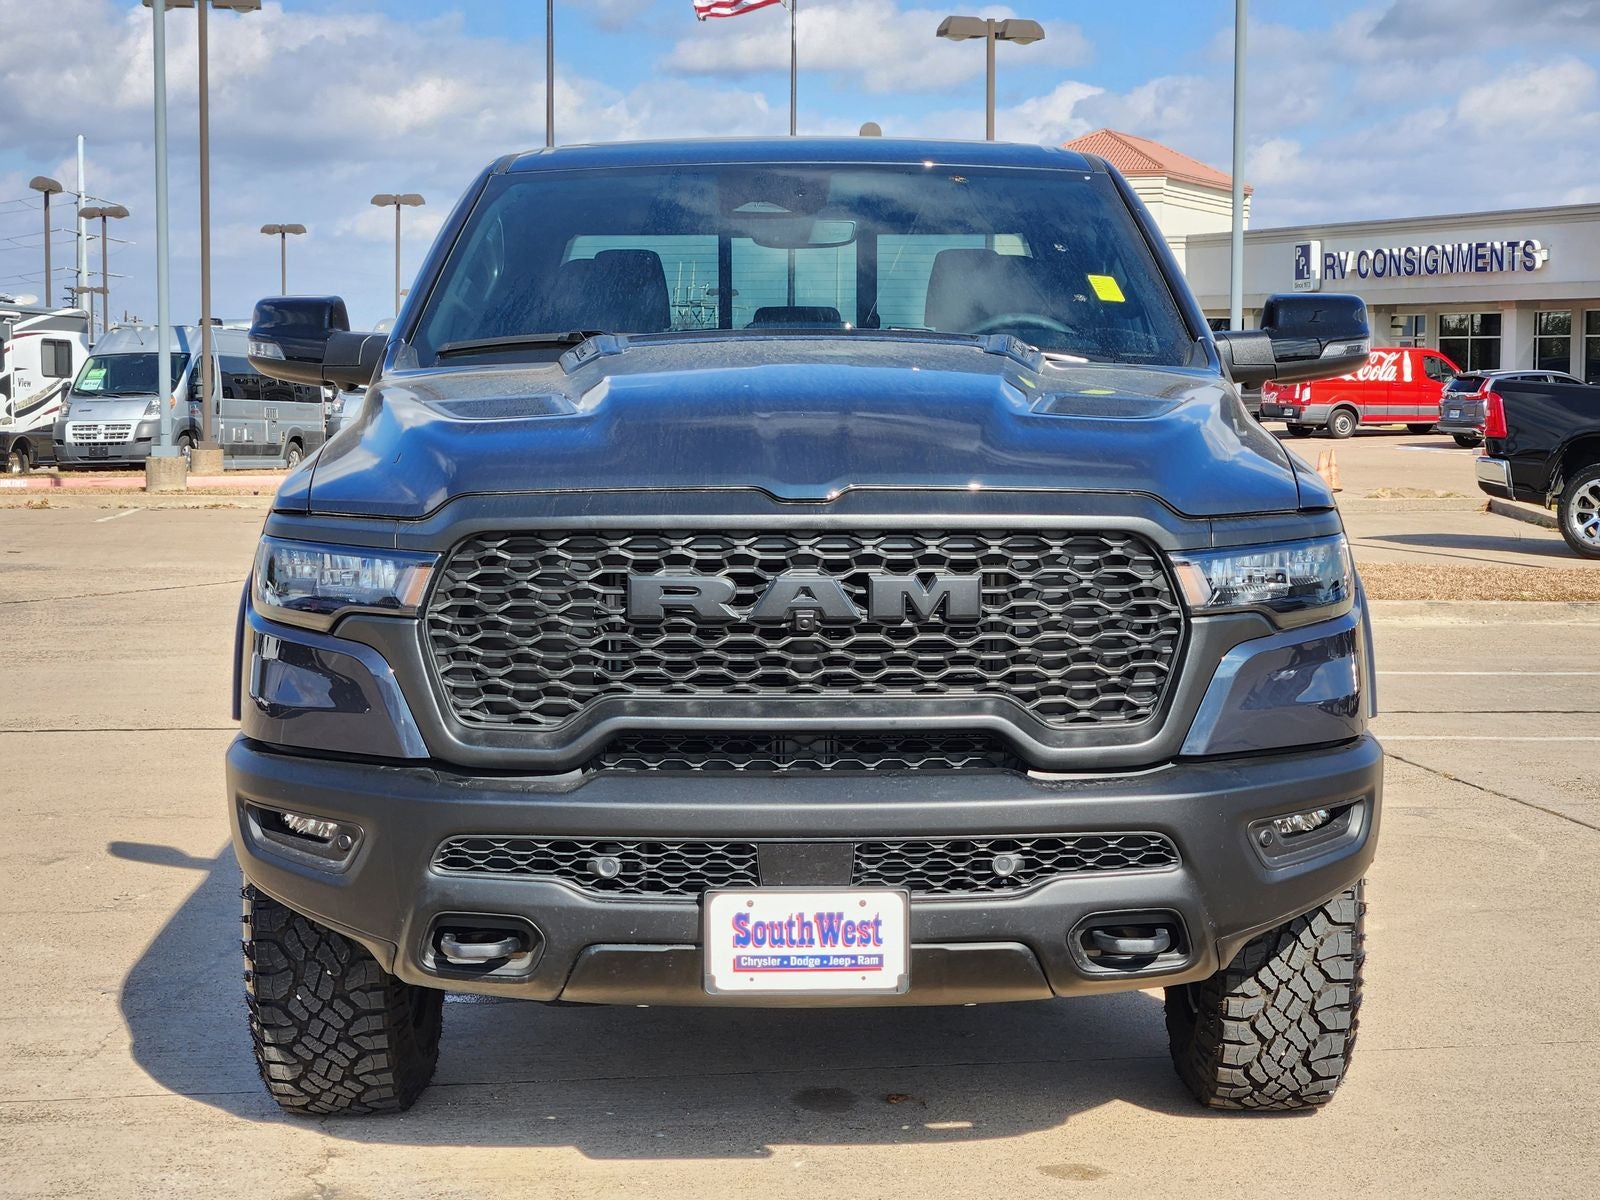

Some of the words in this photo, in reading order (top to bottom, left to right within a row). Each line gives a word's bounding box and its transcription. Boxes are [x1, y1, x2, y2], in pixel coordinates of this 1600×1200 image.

[1324, 251, 1350, 280] RV
[1357, 240, 1537, 279] CONSIGNMENTS
[17, 377, 32, 388] View
[1357, 351, 1401, 382] Cola
[628, 573, 983, 624] RAM
[732, 911, 884, 949] SouthWest
[740, 956, 782, 968] Chrysler
[790, 956, 821, 968] Dodge
[828, 955, 851, 967] Jeep
[857, 955, 880, 966] Ram
